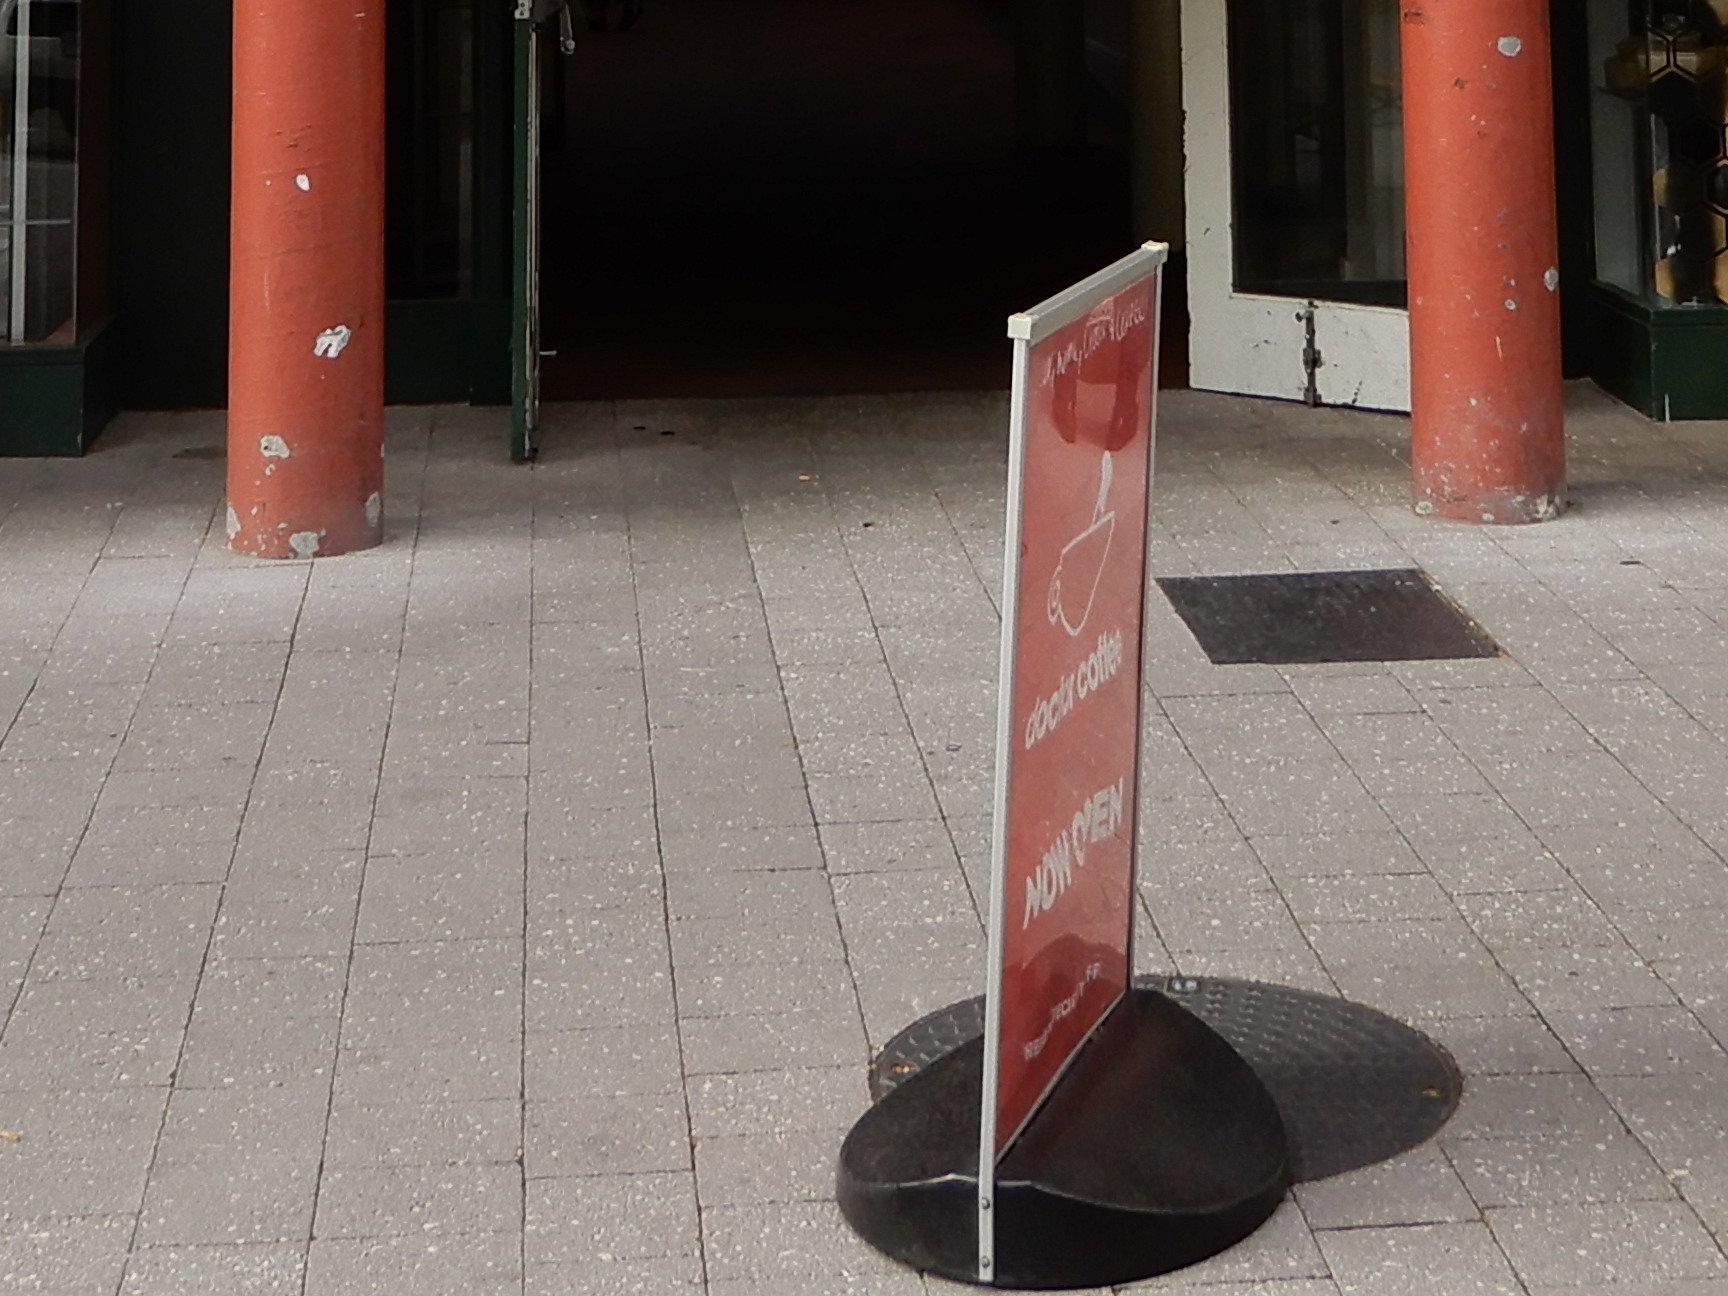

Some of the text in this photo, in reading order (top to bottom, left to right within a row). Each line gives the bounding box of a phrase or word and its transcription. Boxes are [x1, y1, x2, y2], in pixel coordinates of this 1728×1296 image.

[1025, 626, 1123, 750] doctor coffee
[1023, 826, 1072, 931] NOW
